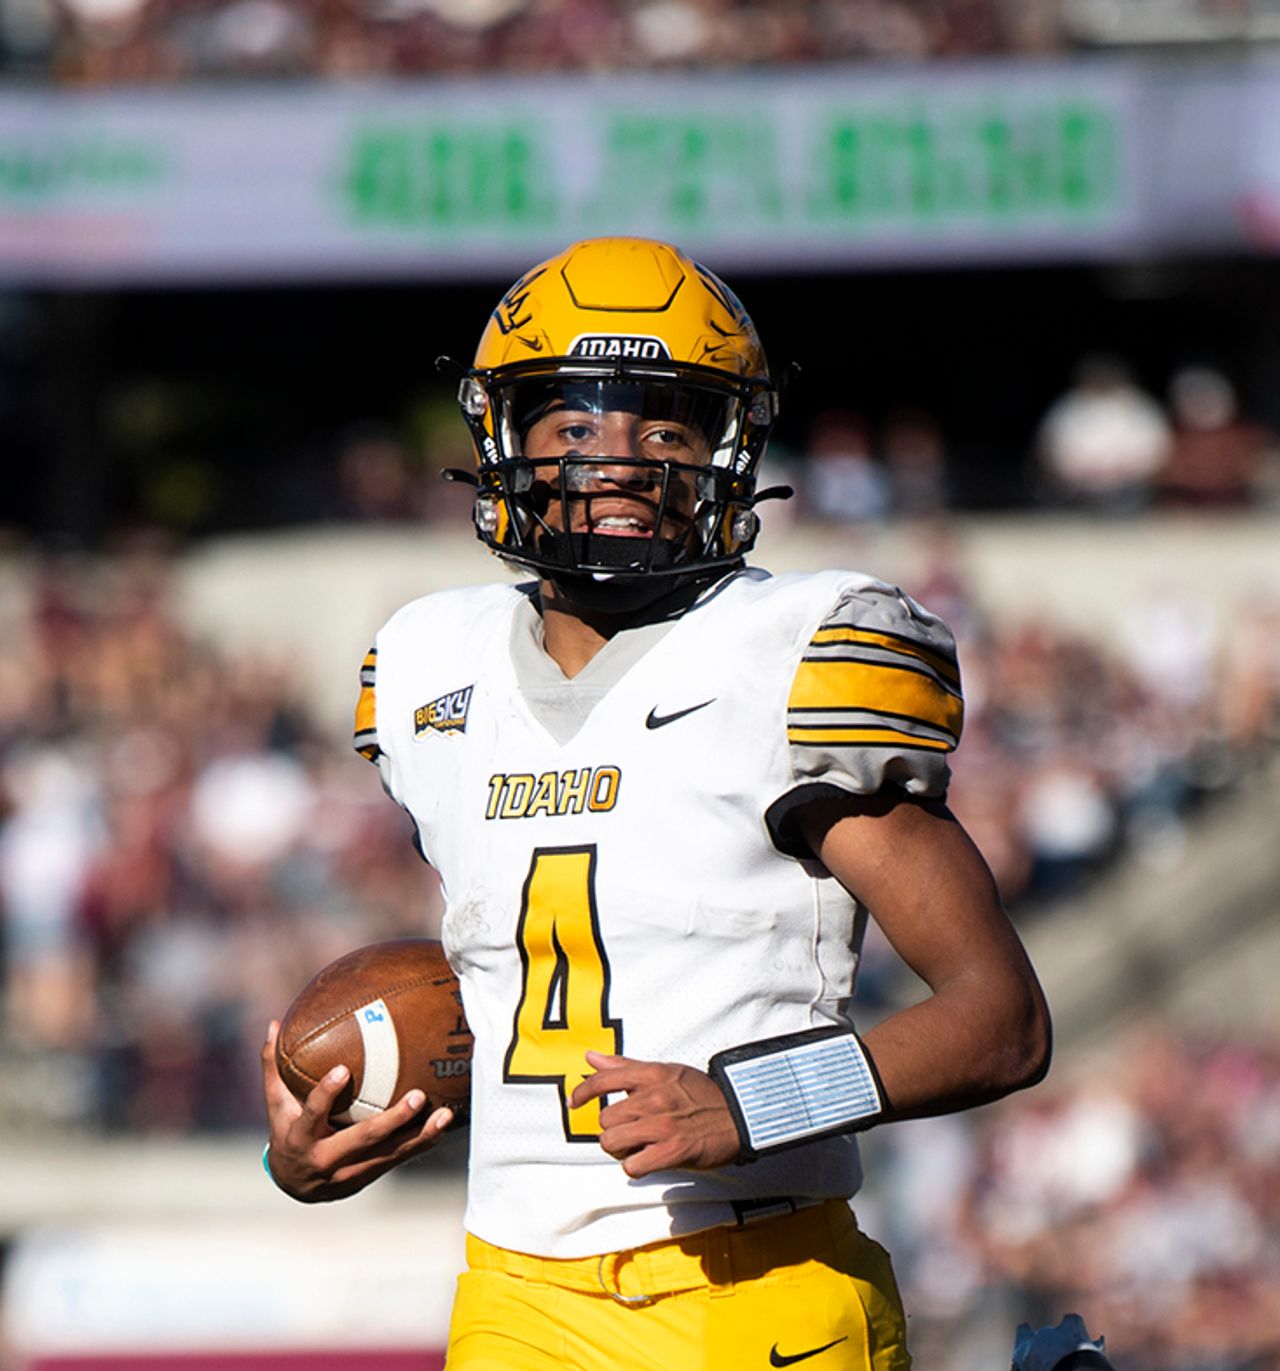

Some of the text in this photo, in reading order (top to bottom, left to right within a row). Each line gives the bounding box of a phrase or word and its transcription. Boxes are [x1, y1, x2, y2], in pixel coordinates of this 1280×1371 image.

[580, 339, 660, 358] IDAHO
[485, 765, 622, 820] IDAHO
[503, 844, 623, 1143] 4
